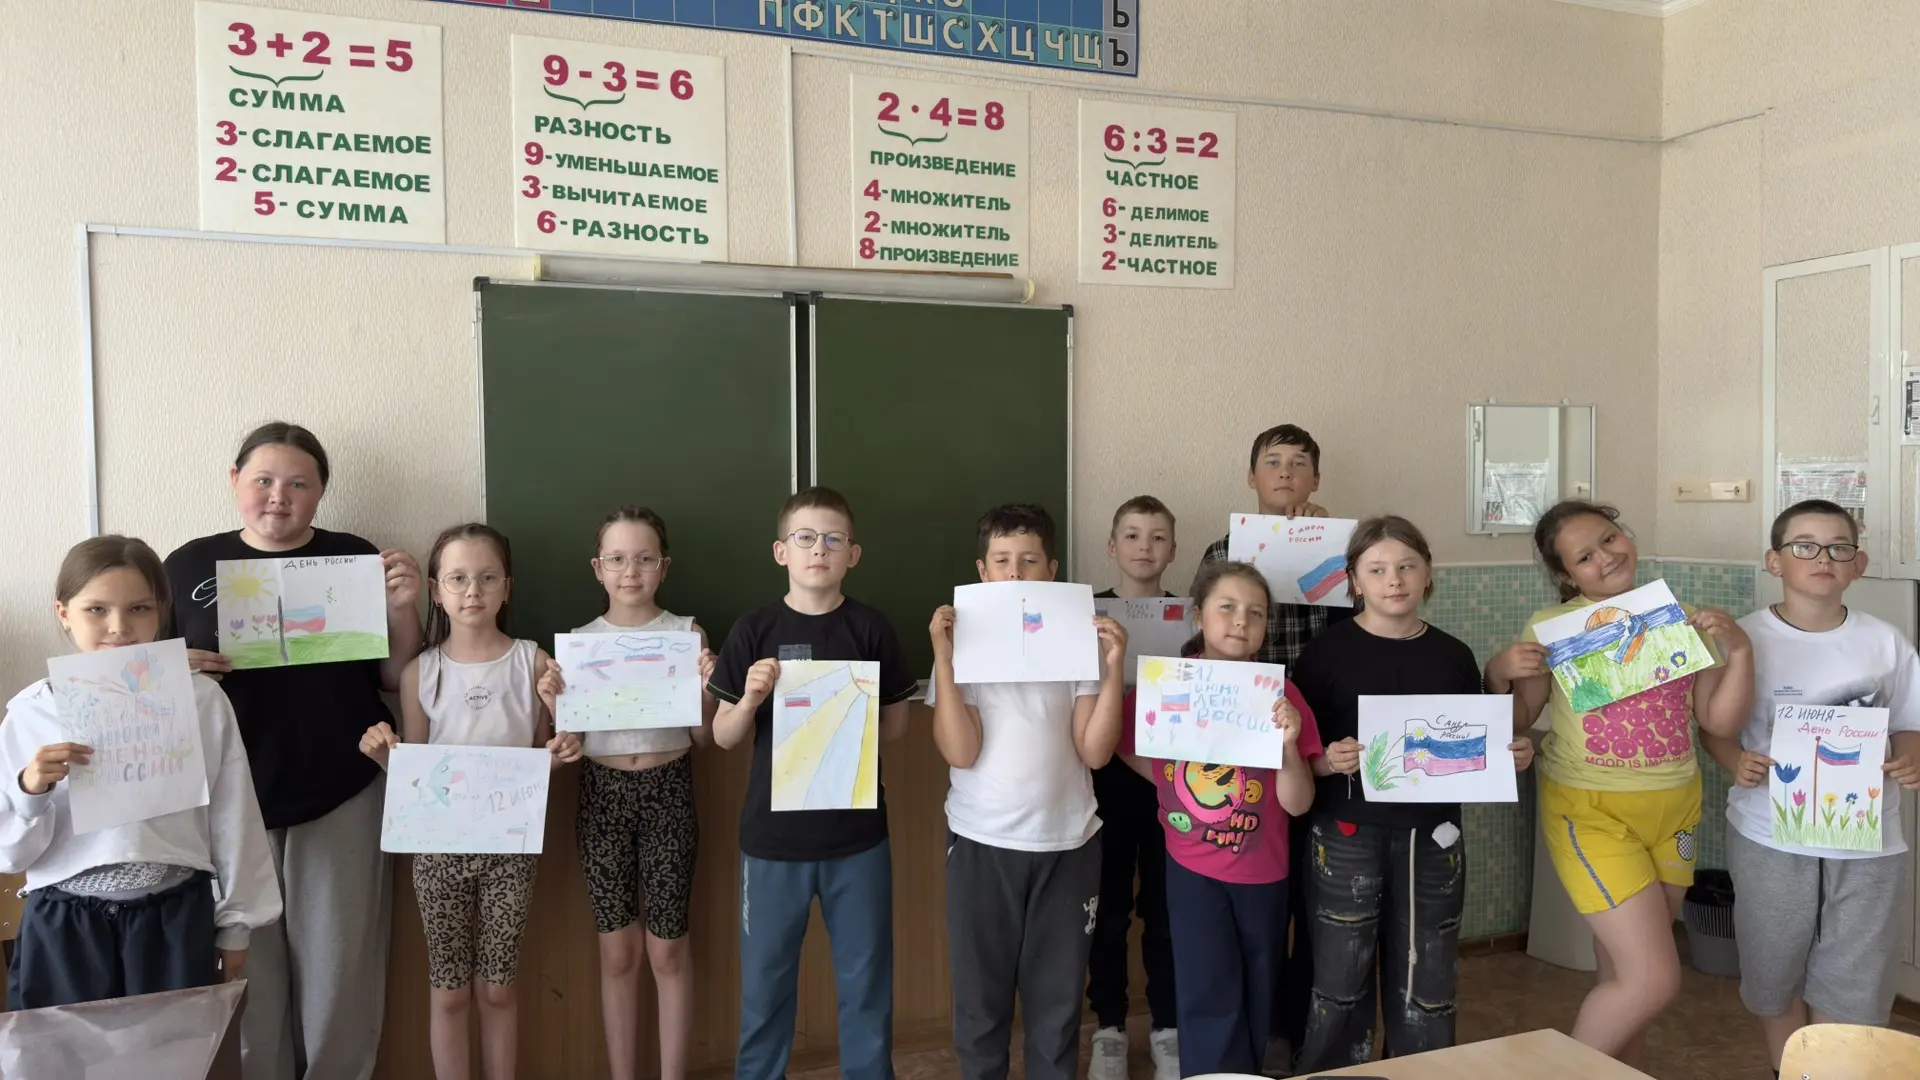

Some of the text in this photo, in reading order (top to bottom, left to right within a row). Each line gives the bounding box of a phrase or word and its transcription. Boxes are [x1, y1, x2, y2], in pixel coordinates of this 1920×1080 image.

[229, 88, 345, 113] СУММА
[535, 115, 672, 145] РАЗНОСТЬ
[870, 150, 1017, 178] ПРОИЗВЕДЕНИЕ
[1106, 170, 1199, 190] ЧАСТНОЕ
[1777, 706, 1793, 719] 12
[1629, 759, 1641, 768] IS
[488, 790, 507, 815] 12
